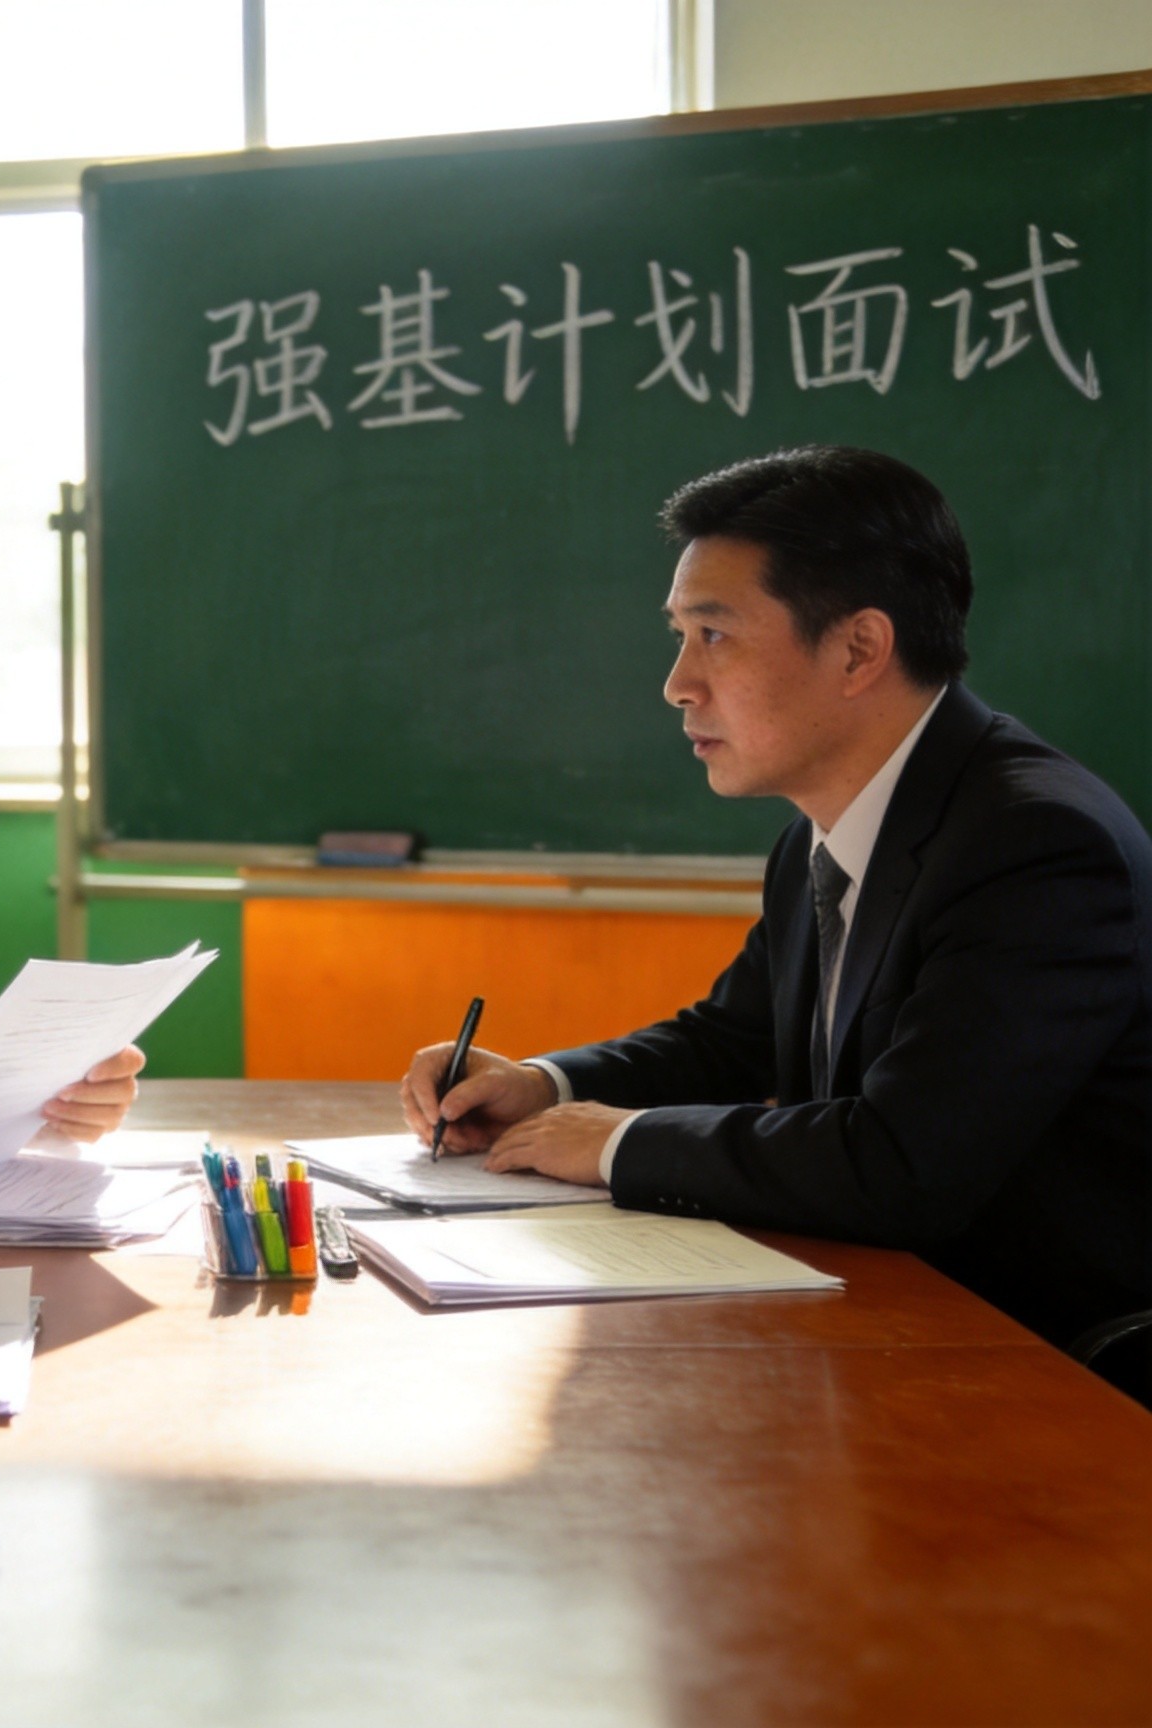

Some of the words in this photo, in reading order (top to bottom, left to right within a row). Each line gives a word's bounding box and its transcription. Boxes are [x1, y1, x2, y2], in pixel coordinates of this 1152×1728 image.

[204, 224, 1101, 446] 强基计划面试
